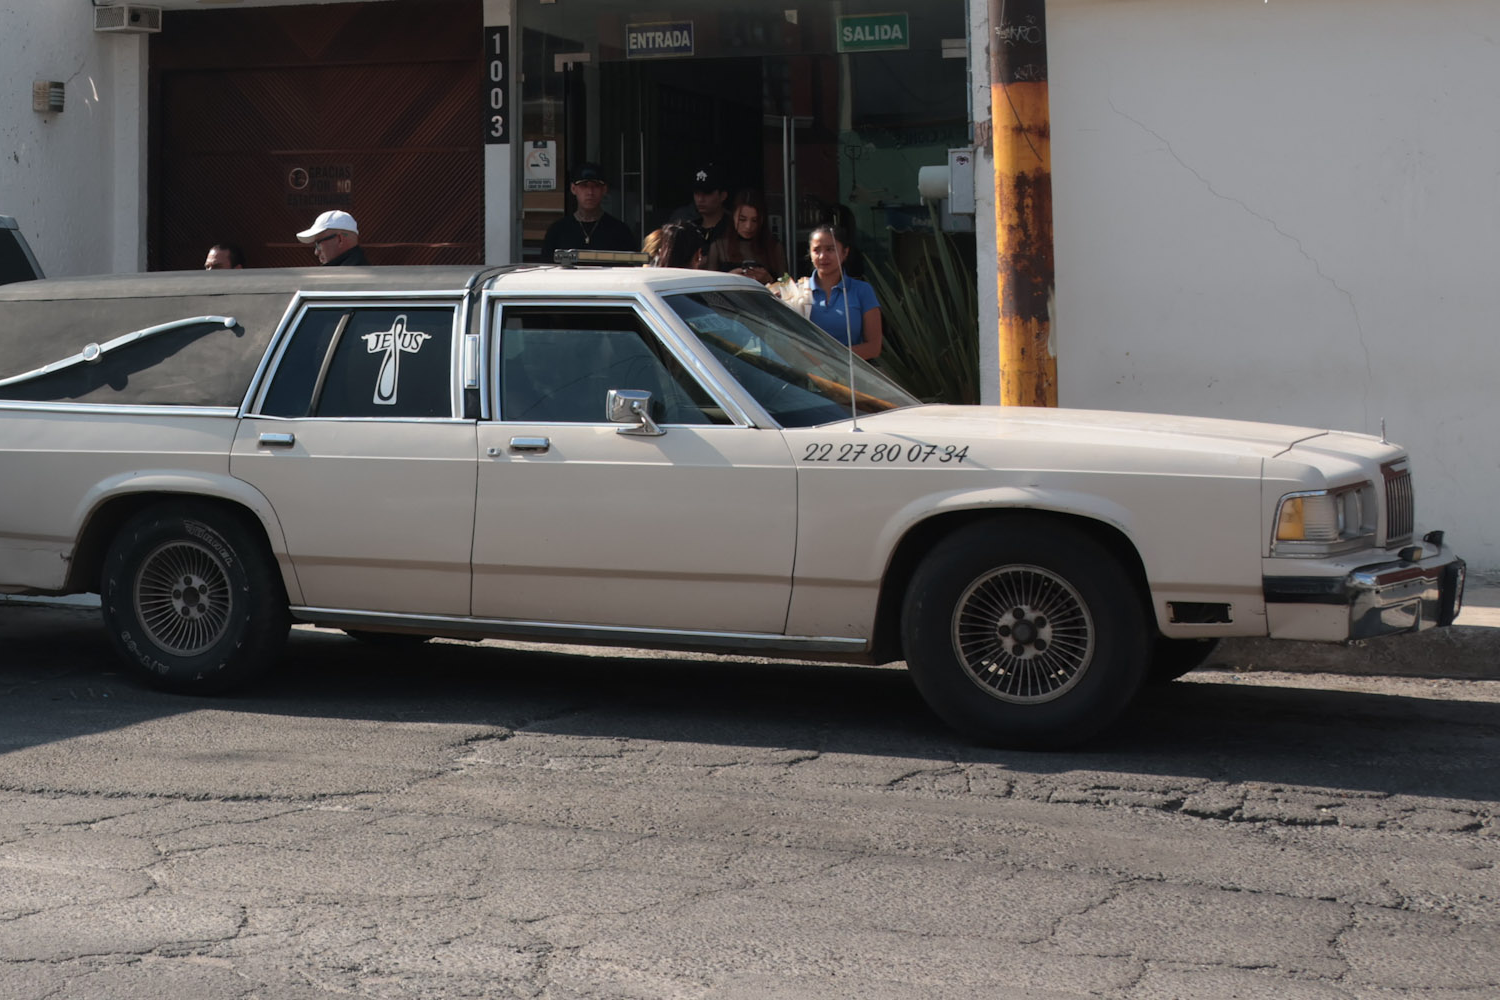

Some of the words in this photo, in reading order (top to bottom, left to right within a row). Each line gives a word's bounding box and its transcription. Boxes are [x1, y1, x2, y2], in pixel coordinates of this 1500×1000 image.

[629, 30, 690, 49] ENTRADA
[843, 24, 903, 42] SALIDA
[490, 32, 503, 137] 1003
[337, 179, 351, 193] NO
[802, 443, 833, 462] 22
[837, 443, 868, 463] 27
[870, 443, 901, 463] 80
[907, 444, 937, 463] 07
[939, 445, 969, 464] 34
